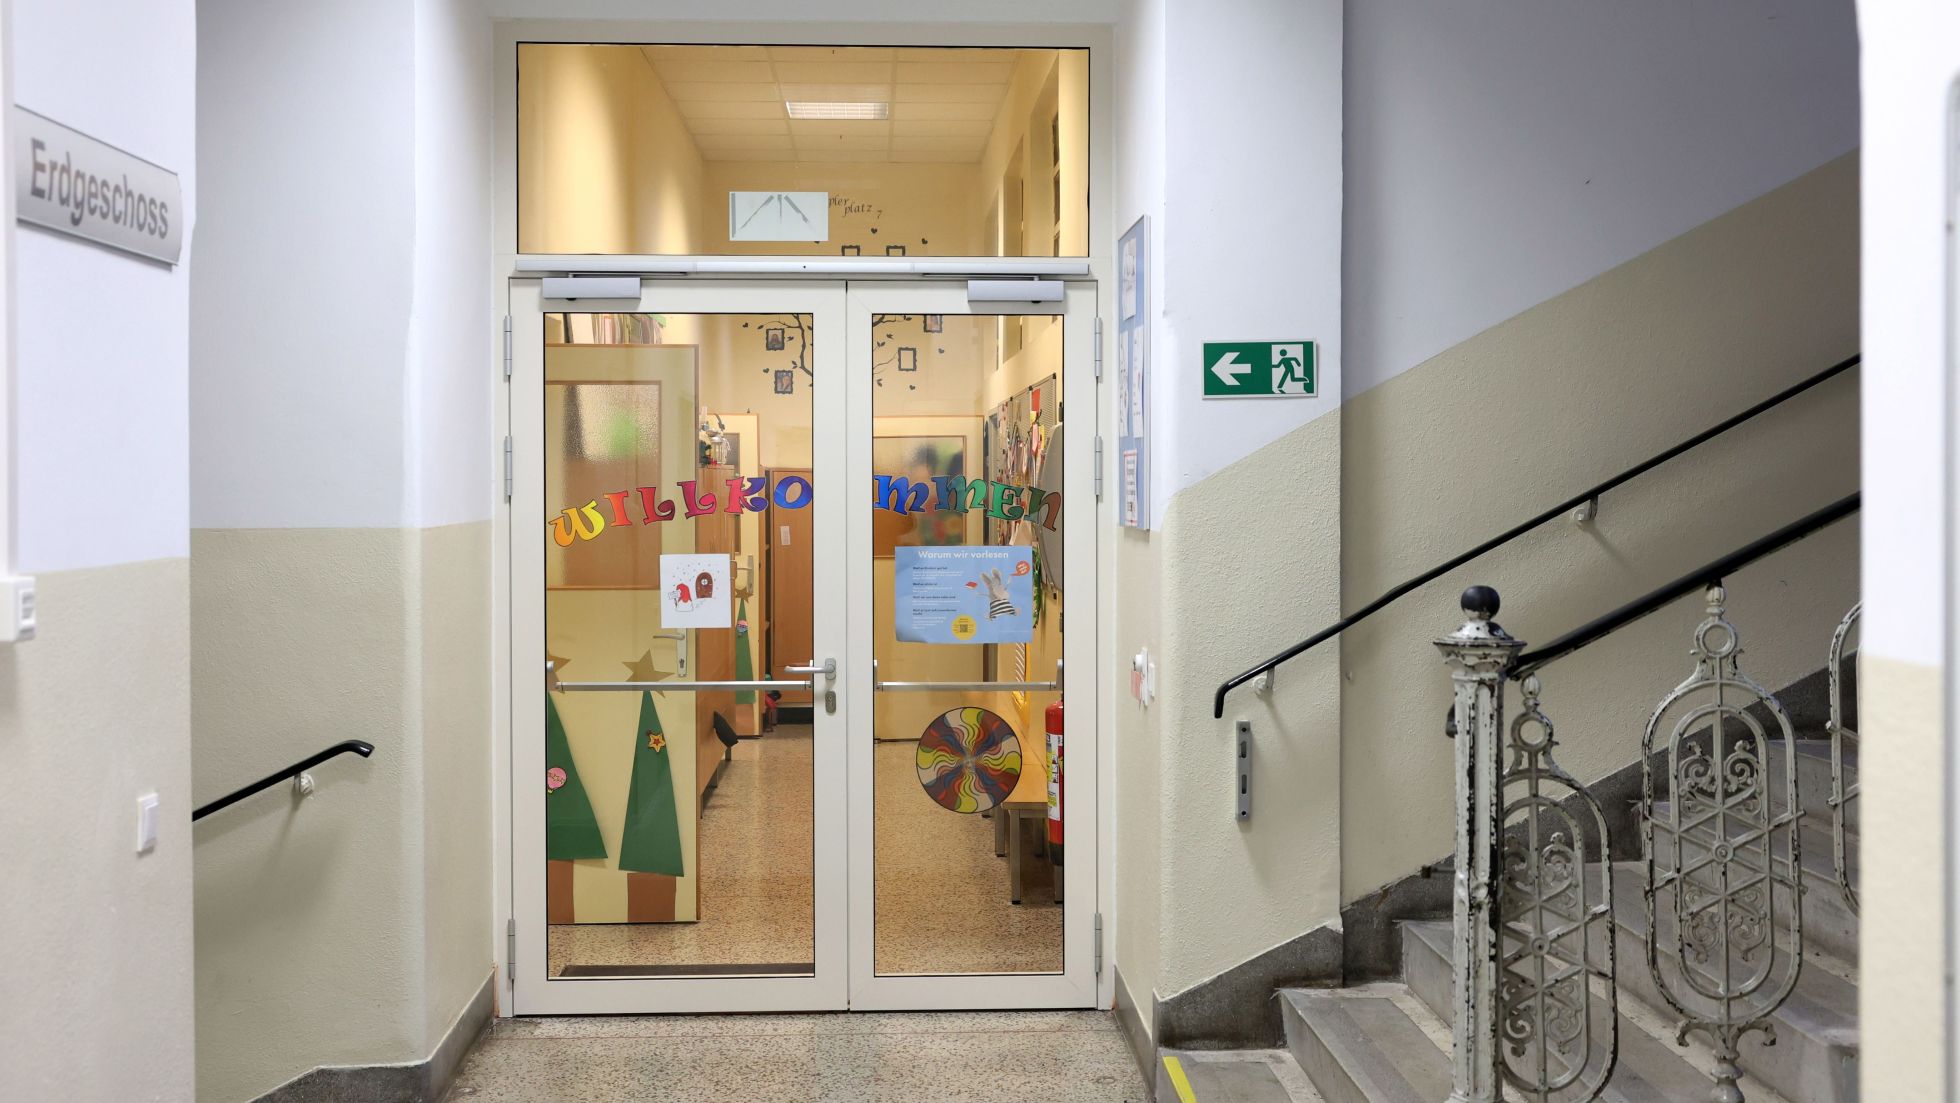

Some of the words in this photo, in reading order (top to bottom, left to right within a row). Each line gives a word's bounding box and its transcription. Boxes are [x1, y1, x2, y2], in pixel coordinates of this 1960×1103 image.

[30, 136, 169, 240] Erdgeschoss
[841, 201, 872, 217] platz
[918, 550, 952, 559] Warum
[954, 550, 969, 559] wir
[970, 550, 1009, 559] vorlesen
